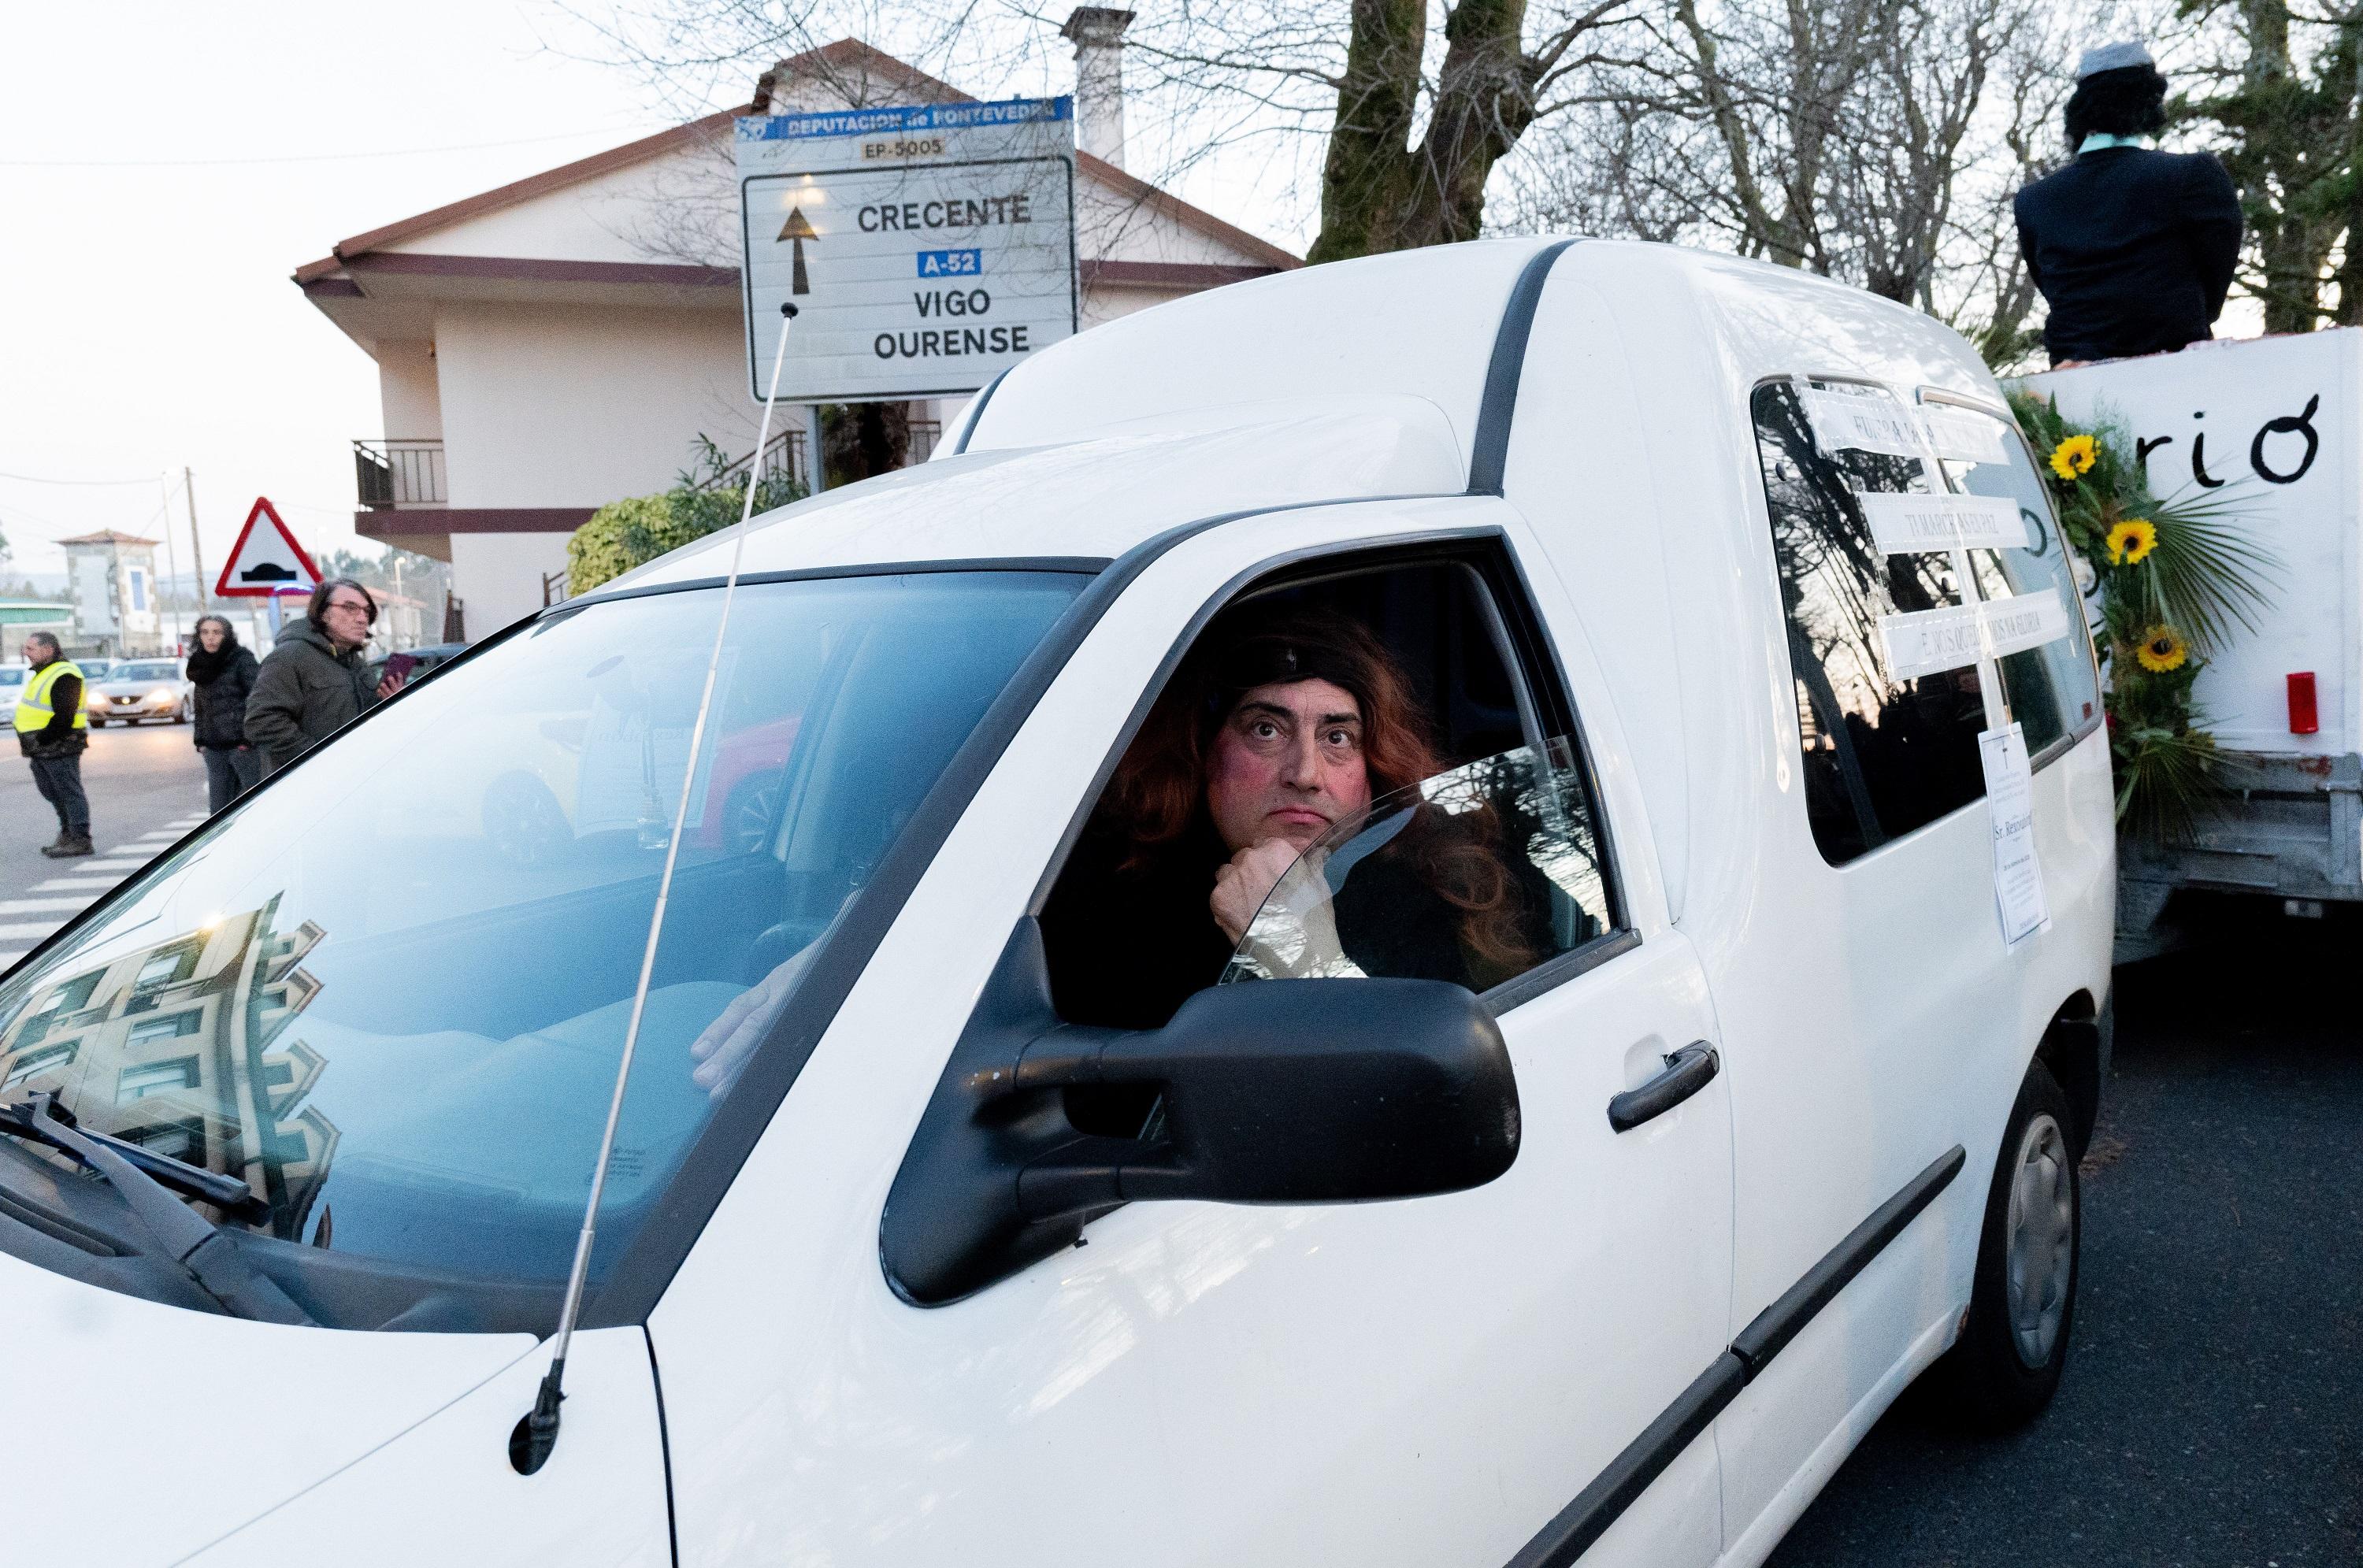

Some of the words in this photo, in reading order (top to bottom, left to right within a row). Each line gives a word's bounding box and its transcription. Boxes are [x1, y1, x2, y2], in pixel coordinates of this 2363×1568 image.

[933, 102, 1055, 126] PONTEVEDRA
[866, 139, 942, 158] EP-5005
[859, 195, 1031, 232] CRECENTE
[924, 253, 976, 274] A-52
[914, 289, 991, 317] VIGO
[874, 326, 1029, 359] OURENSE
